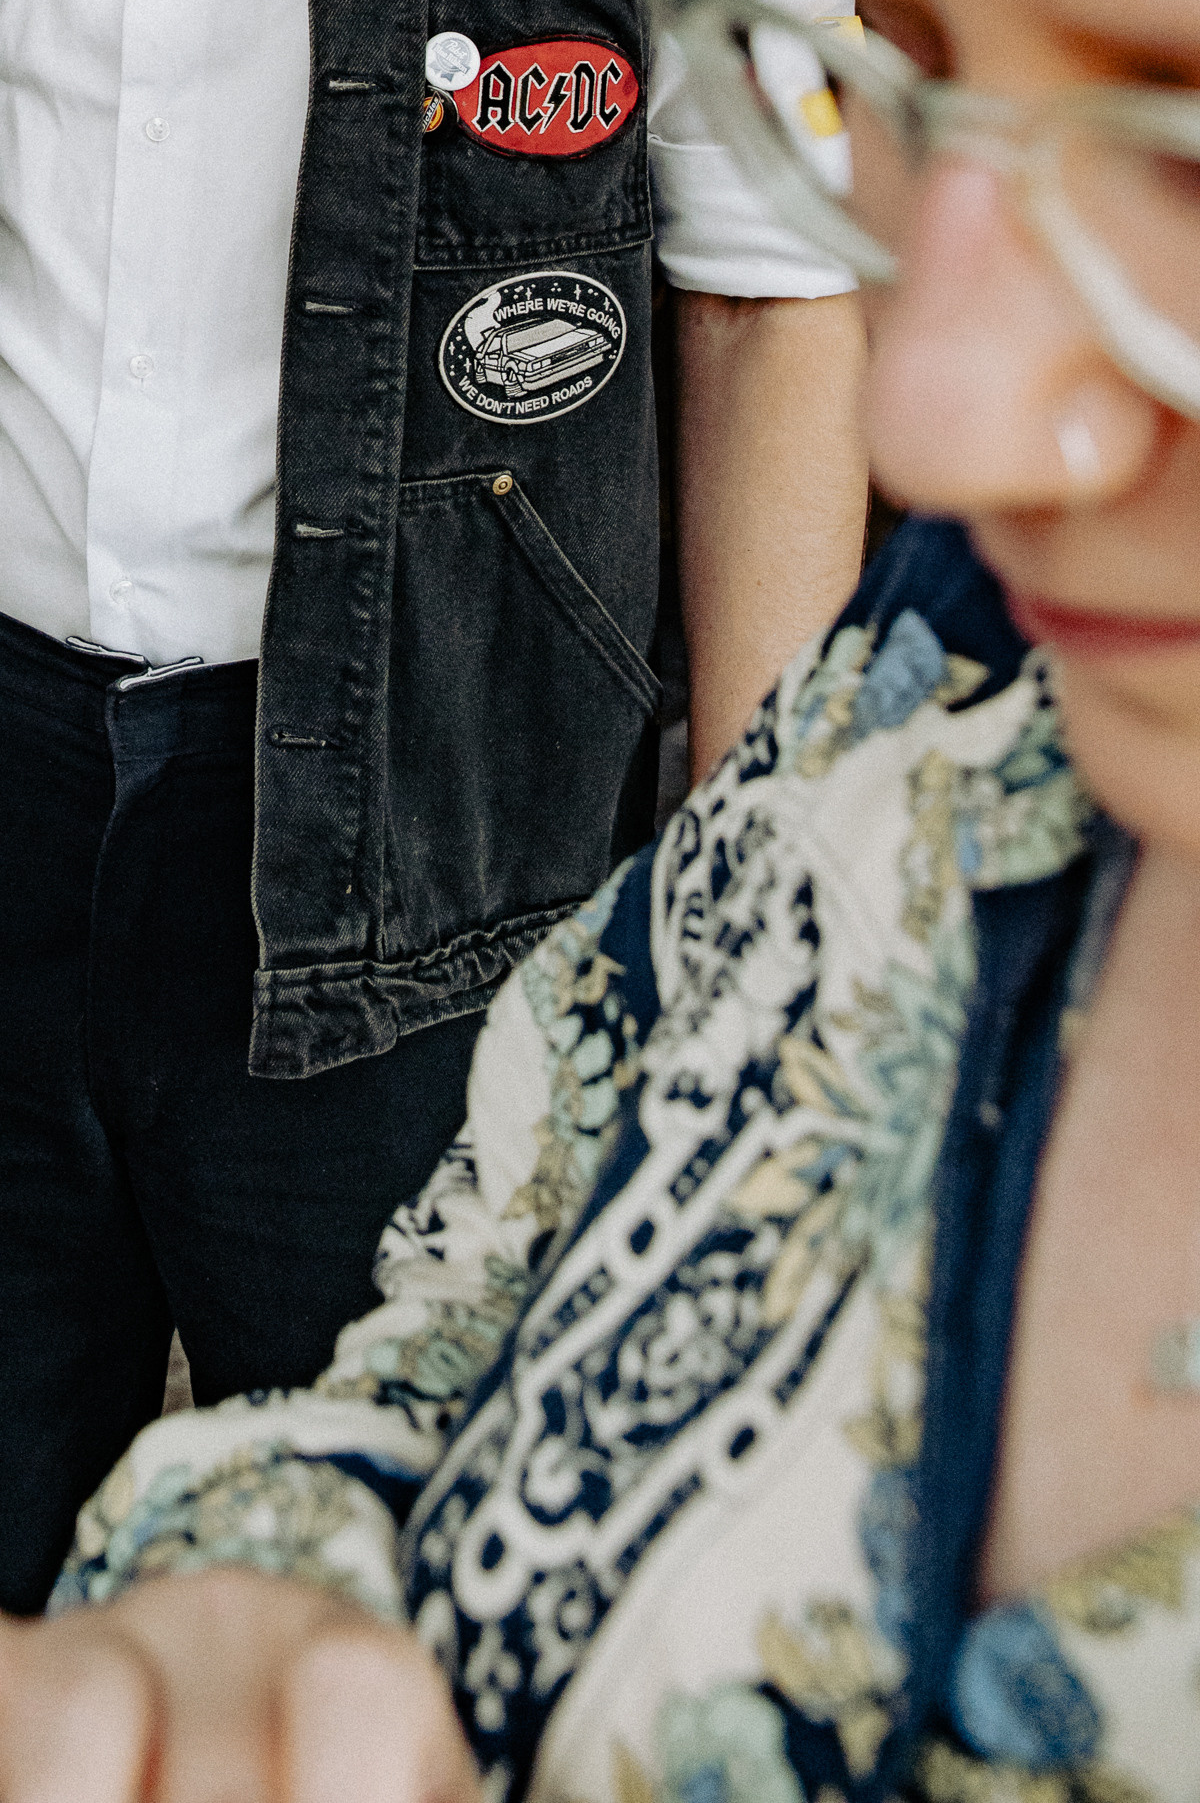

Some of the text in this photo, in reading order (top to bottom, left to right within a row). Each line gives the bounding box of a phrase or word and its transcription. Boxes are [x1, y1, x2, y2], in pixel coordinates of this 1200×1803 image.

[494, 297, 622, 340] WHERE WE'RE GOING
[458, 375, 594, 415] WE DON'T NEED ROADS
